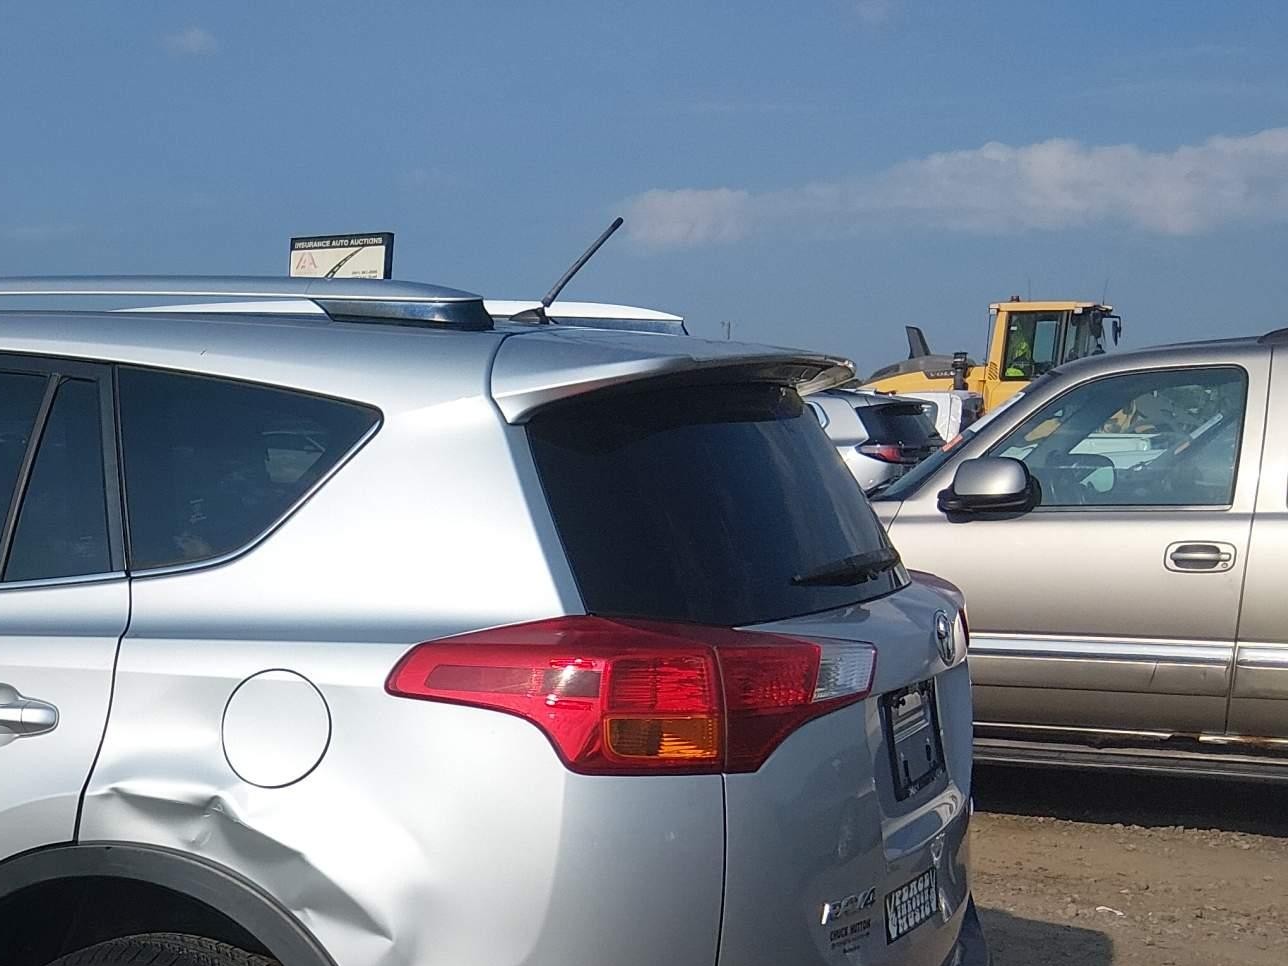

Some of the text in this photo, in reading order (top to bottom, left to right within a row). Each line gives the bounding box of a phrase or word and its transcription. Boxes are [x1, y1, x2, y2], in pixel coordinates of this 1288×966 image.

[294, 237, 383, 249] INSURANCE AUTO AUCTIONS
[898, 901, 931, 935] MUSIC
